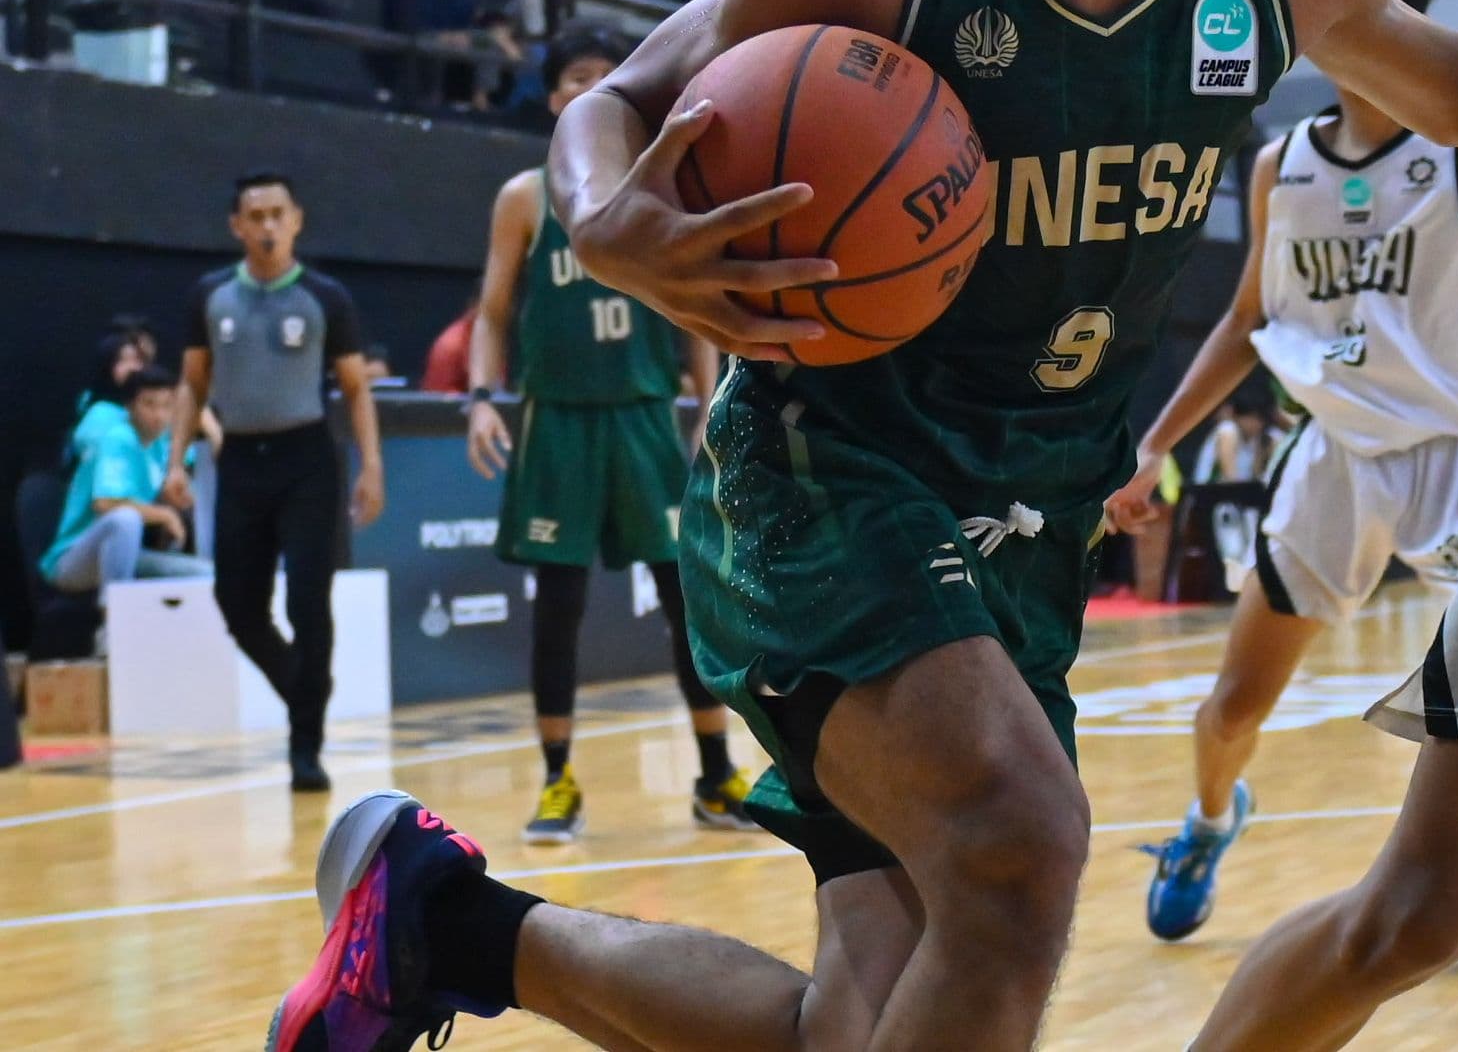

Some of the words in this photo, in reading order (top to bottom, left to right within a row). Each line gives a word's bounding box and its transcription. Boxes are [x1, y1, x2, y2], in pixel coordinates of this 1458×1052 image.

[1199, 59, 1251, 73] CAMPUS
[966, 69, 1003, 79] UNESA
[1198, 73, 1248, 87] LEAGUE
[590, 297, 632, 342] 10
[1030, 305, 1115, 392] 9
